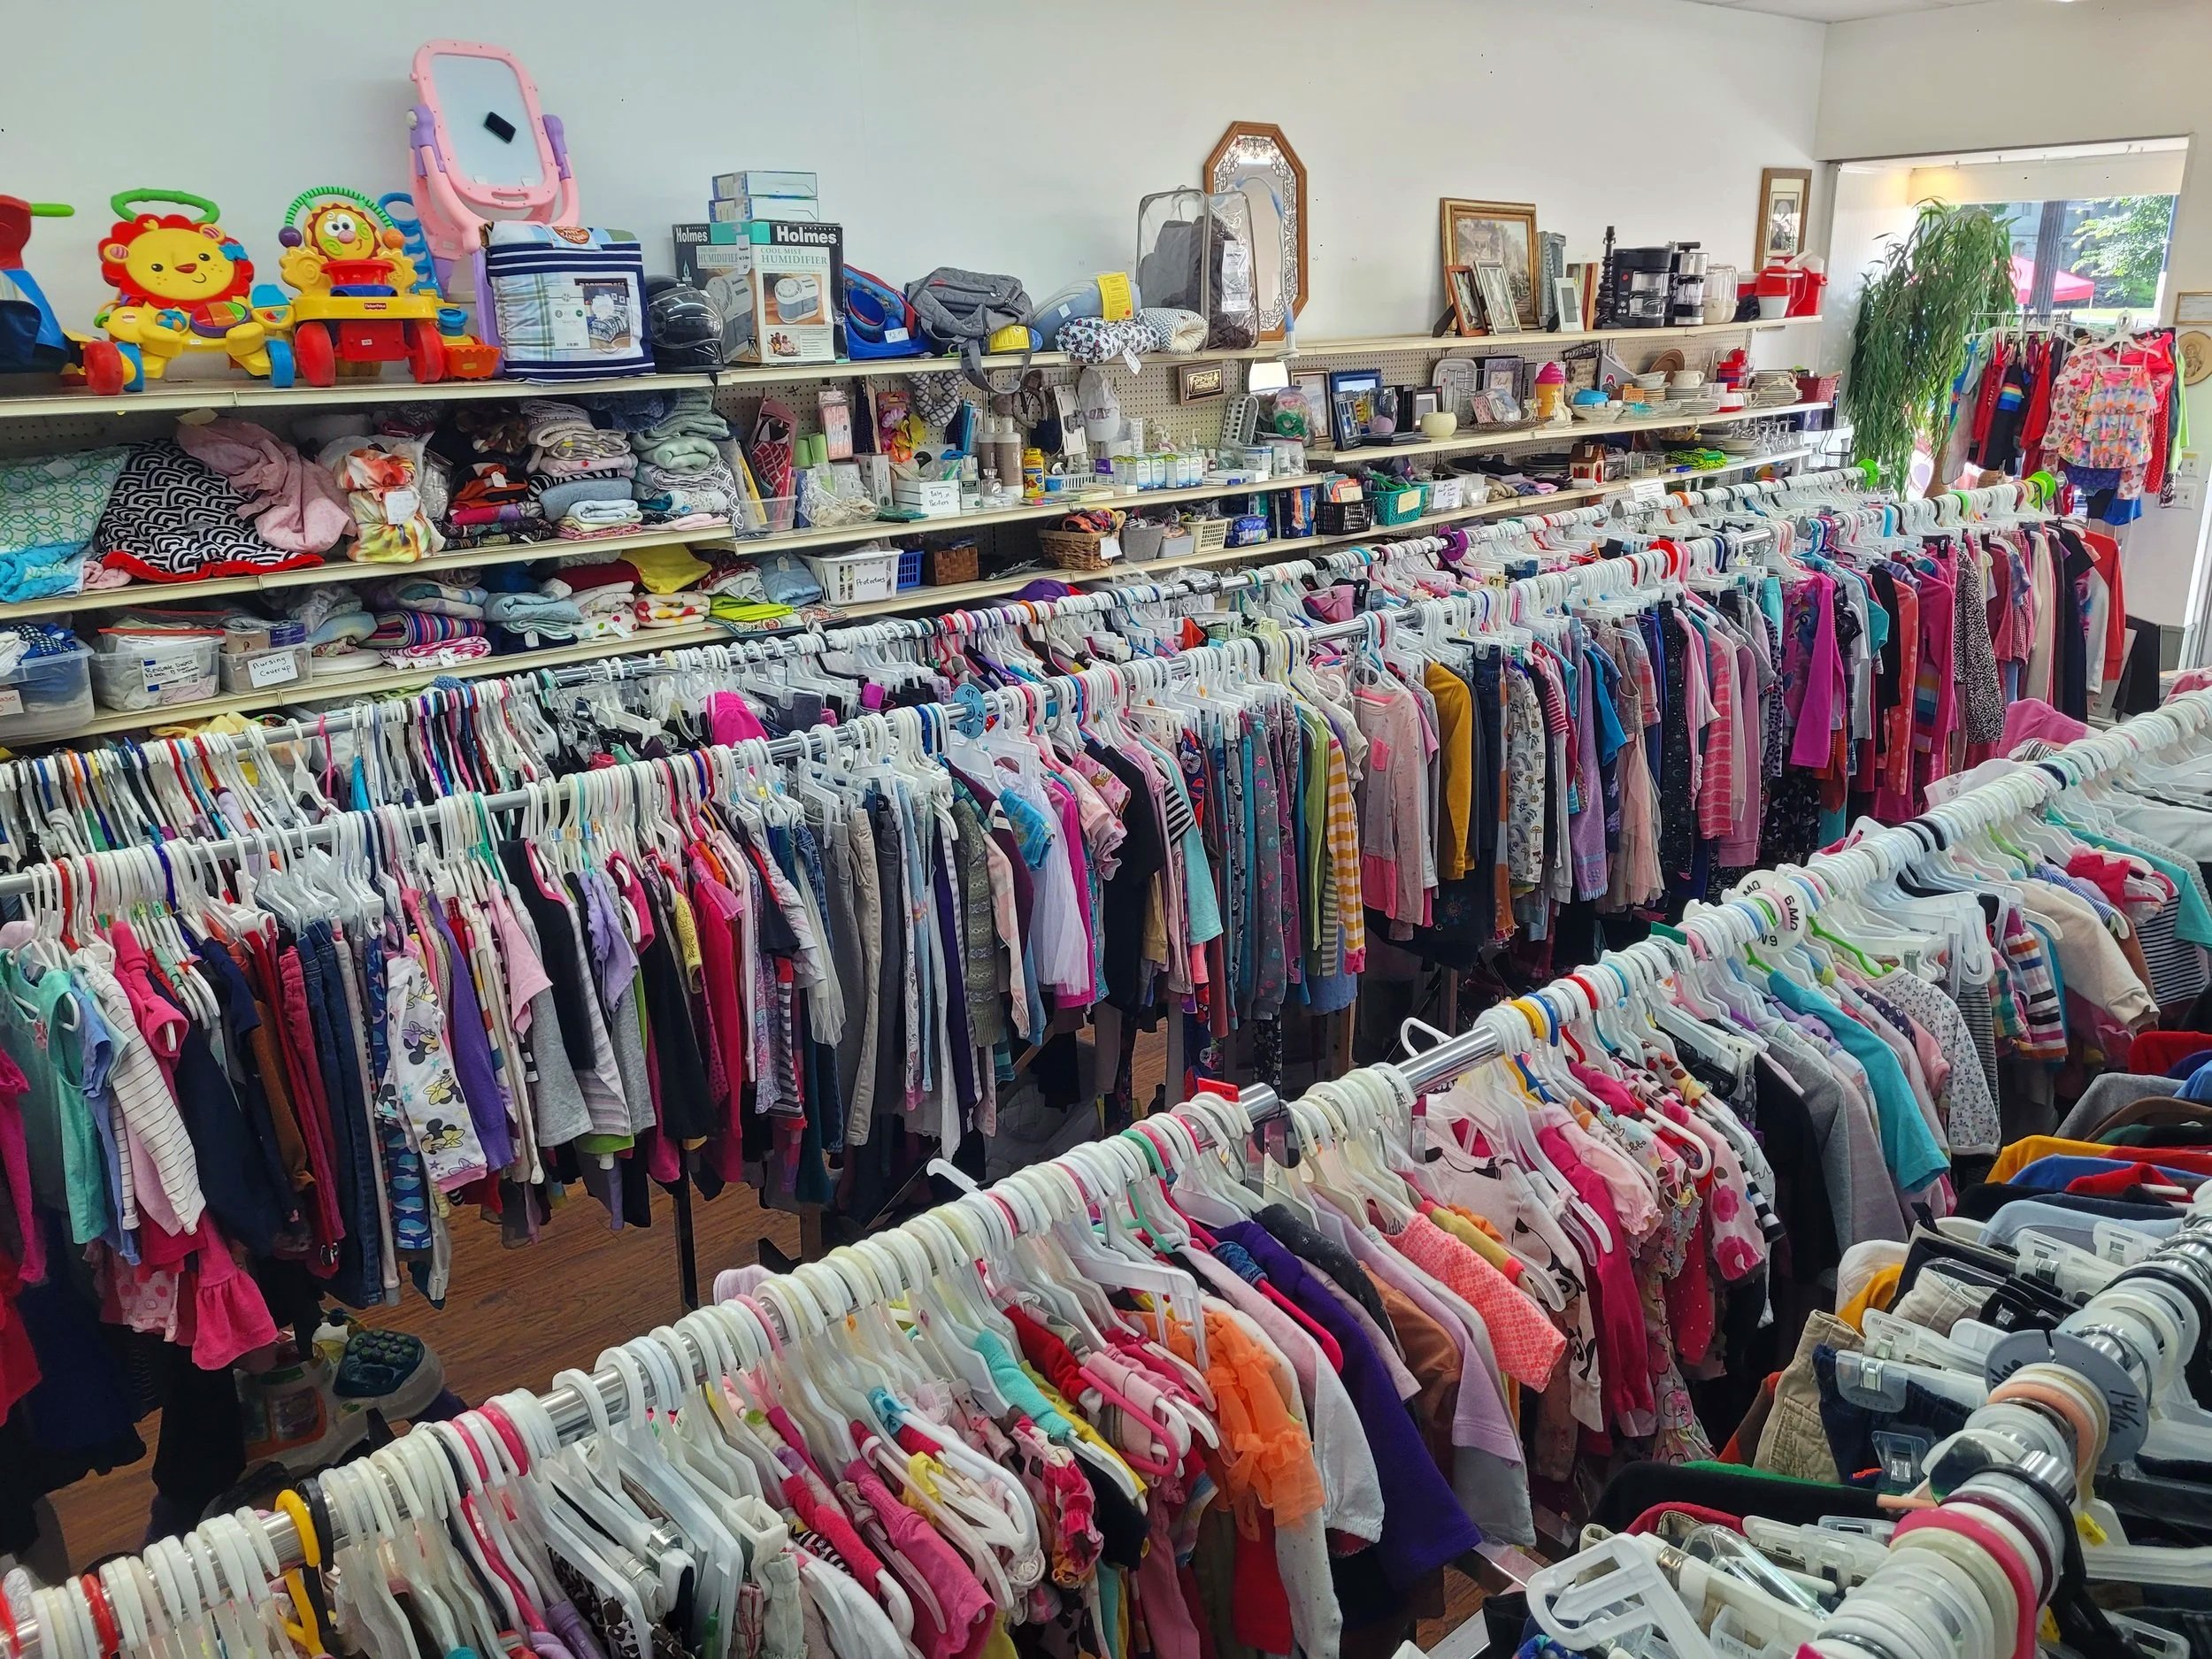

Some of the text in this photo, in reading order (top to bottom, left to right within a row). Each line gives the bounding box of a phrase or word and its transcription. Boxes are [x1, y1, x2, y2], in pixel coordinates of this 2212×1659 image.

[676, 227, 708, 243] Holmes
[776, 225, 837, 244] Holmes
[762, 254, 828, 265] HUMIDIFIER
[1261, 619, 1274, 633] 5T
[964, 688, 976, 700] 4T
[976, 710, 985, 726] 4T
